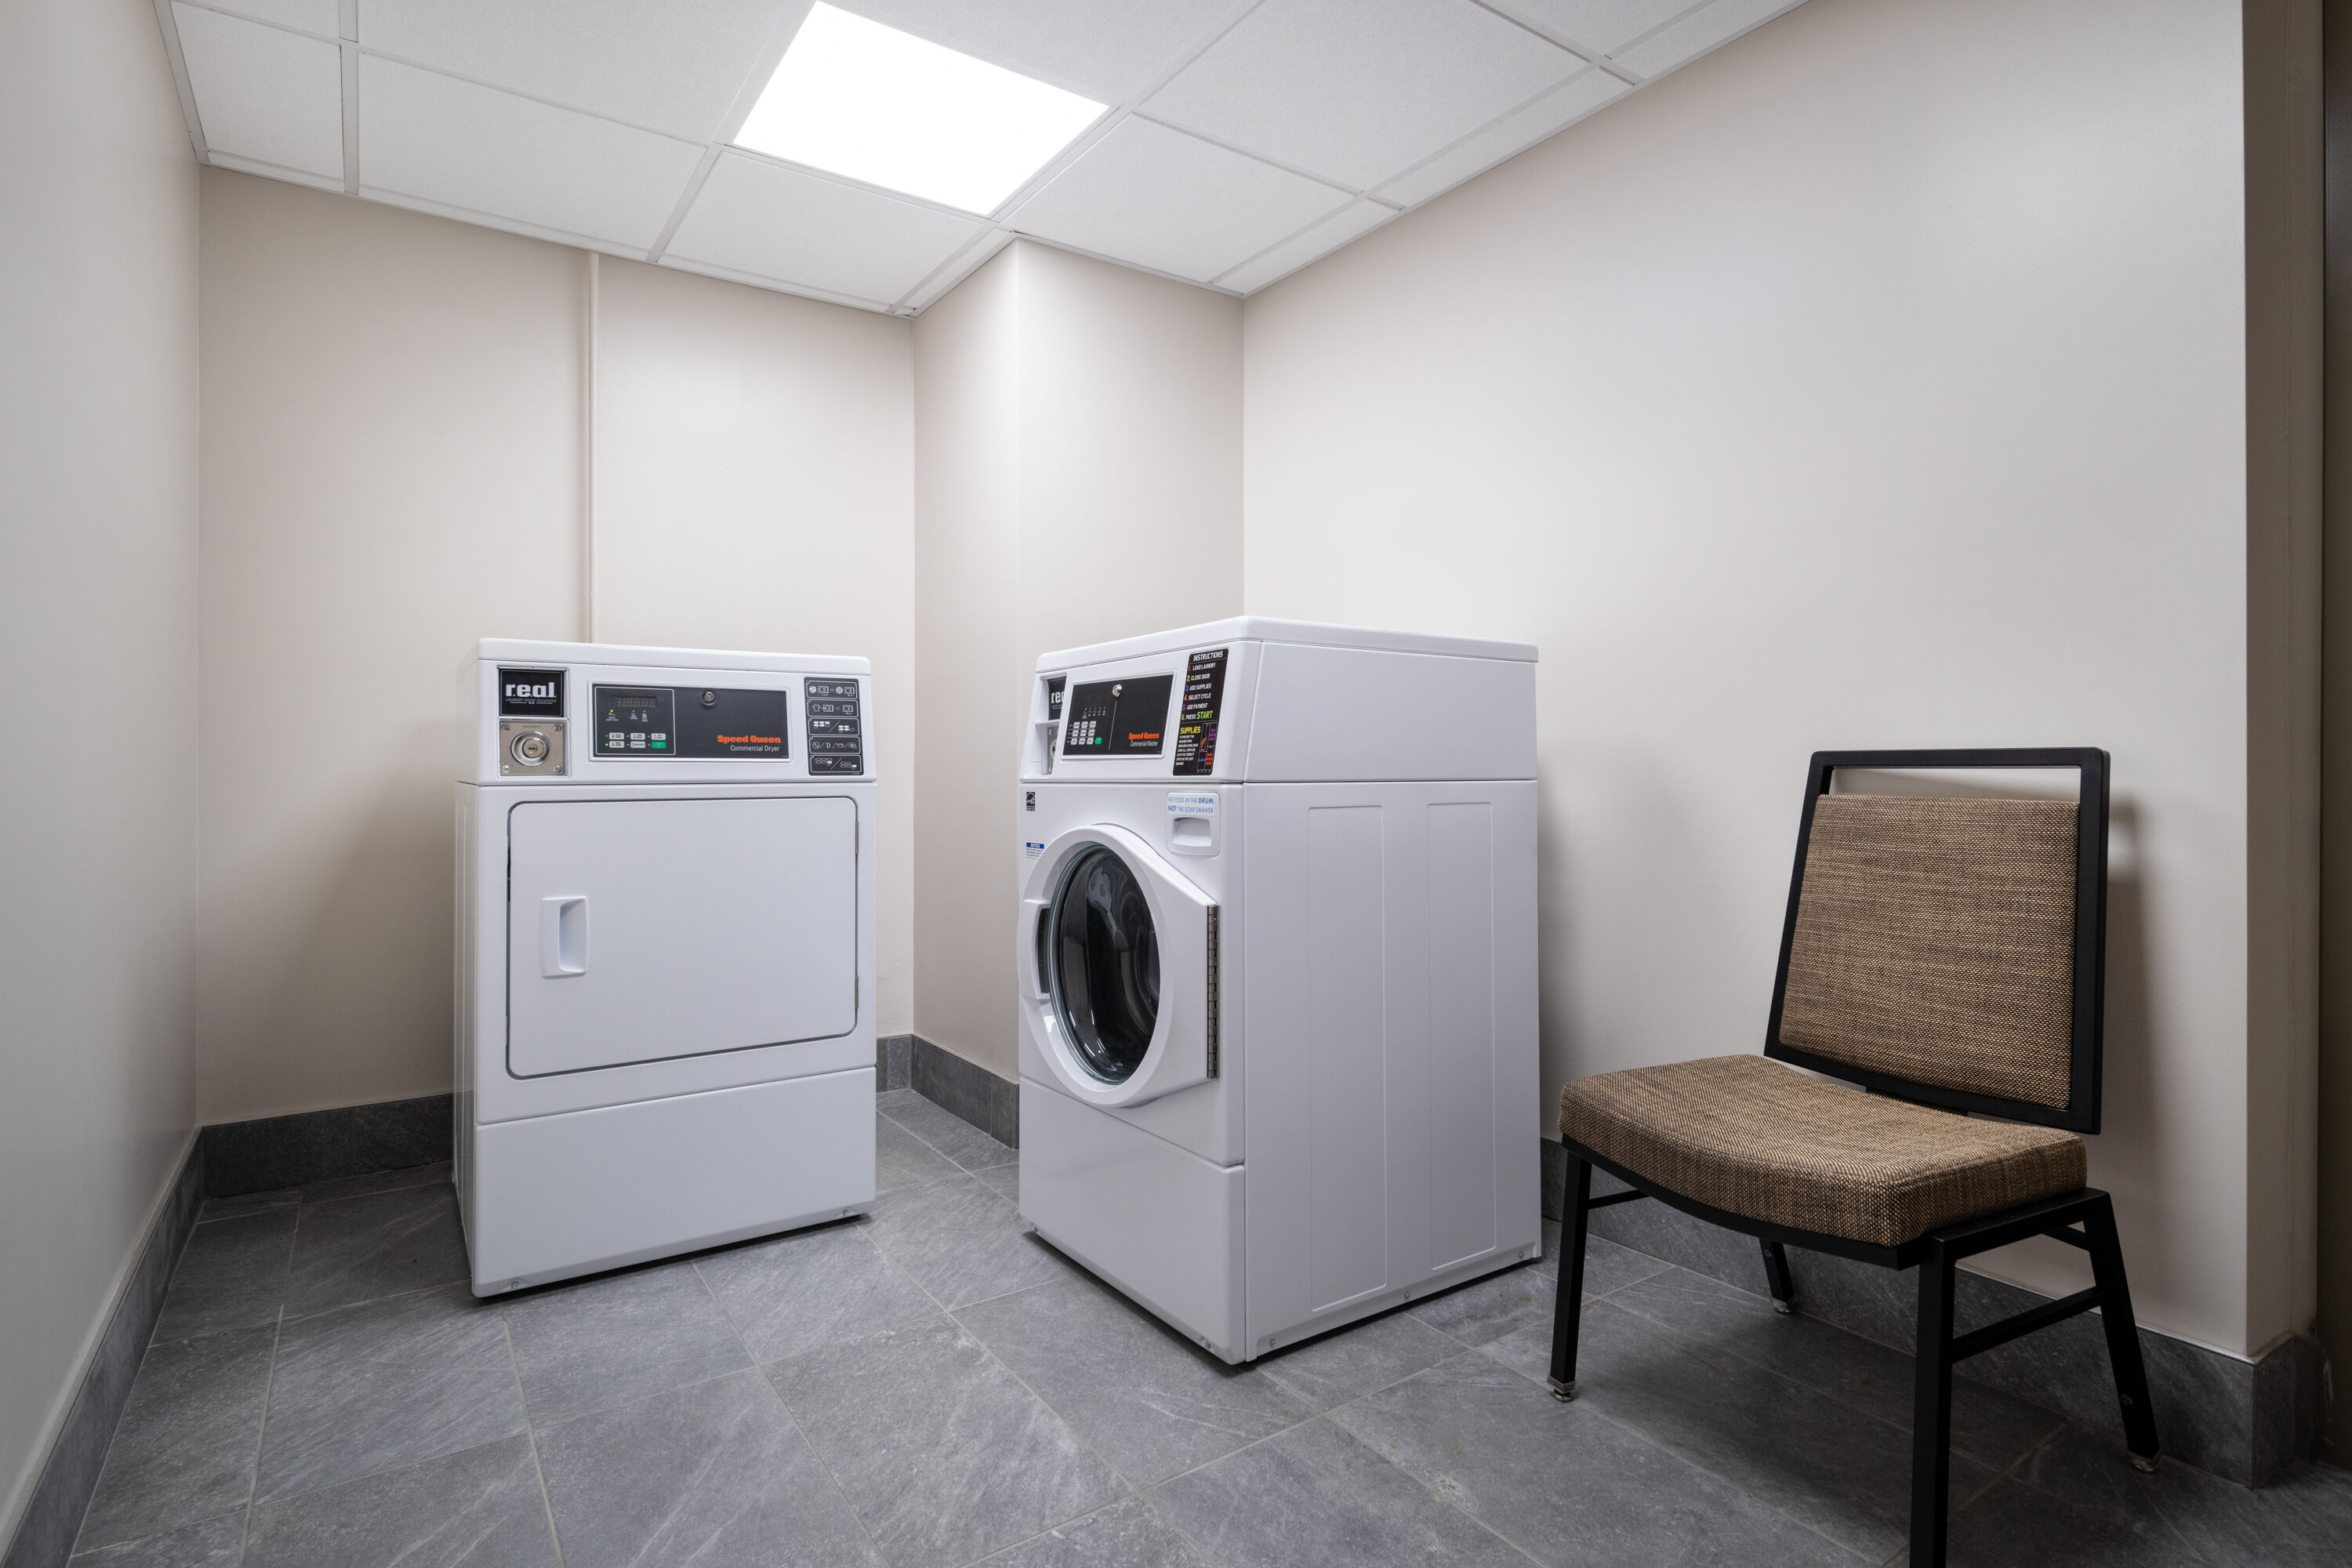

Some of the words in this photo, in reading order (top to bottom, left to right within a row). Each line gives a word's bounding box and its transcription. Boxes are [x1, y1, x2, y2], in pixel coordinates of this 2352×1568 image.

[1193, 651, 1223, 662] INSTRUCTIONS
[1196, 710, 1213, 720] START
[1180, 726, 1201, 735] SUPPLIES
[717, 735, 749, 744] Speed
[750, 735, 781, 743] Queen
[1129, 732, 1144, 741] Speed
